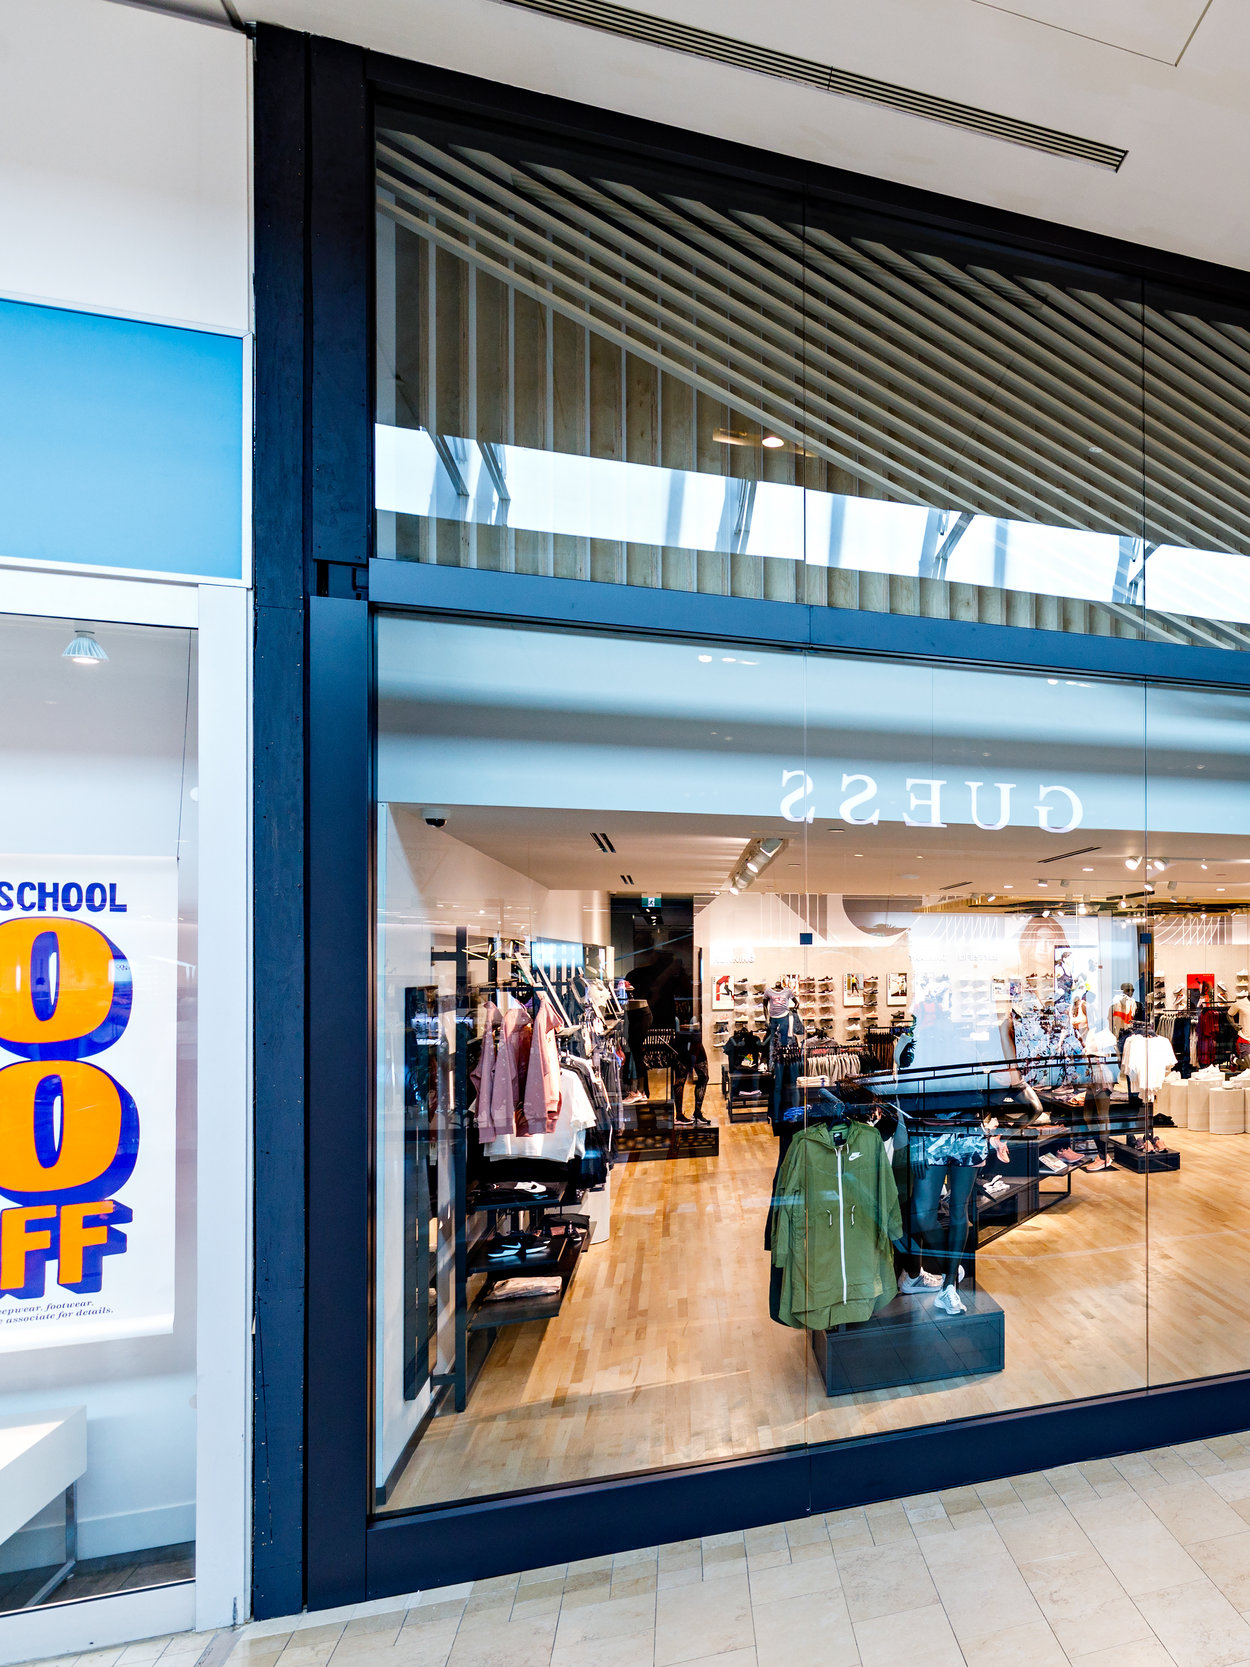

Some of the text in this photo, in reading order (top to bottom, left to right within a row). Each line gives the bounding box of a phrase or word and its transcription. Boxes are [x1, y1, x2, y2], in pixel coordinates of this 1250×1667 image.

[0, 881, 127, 912] SCHOOL
[6, 1314, 55, 1324] associate
[57, 1310, 74, 1320] for
